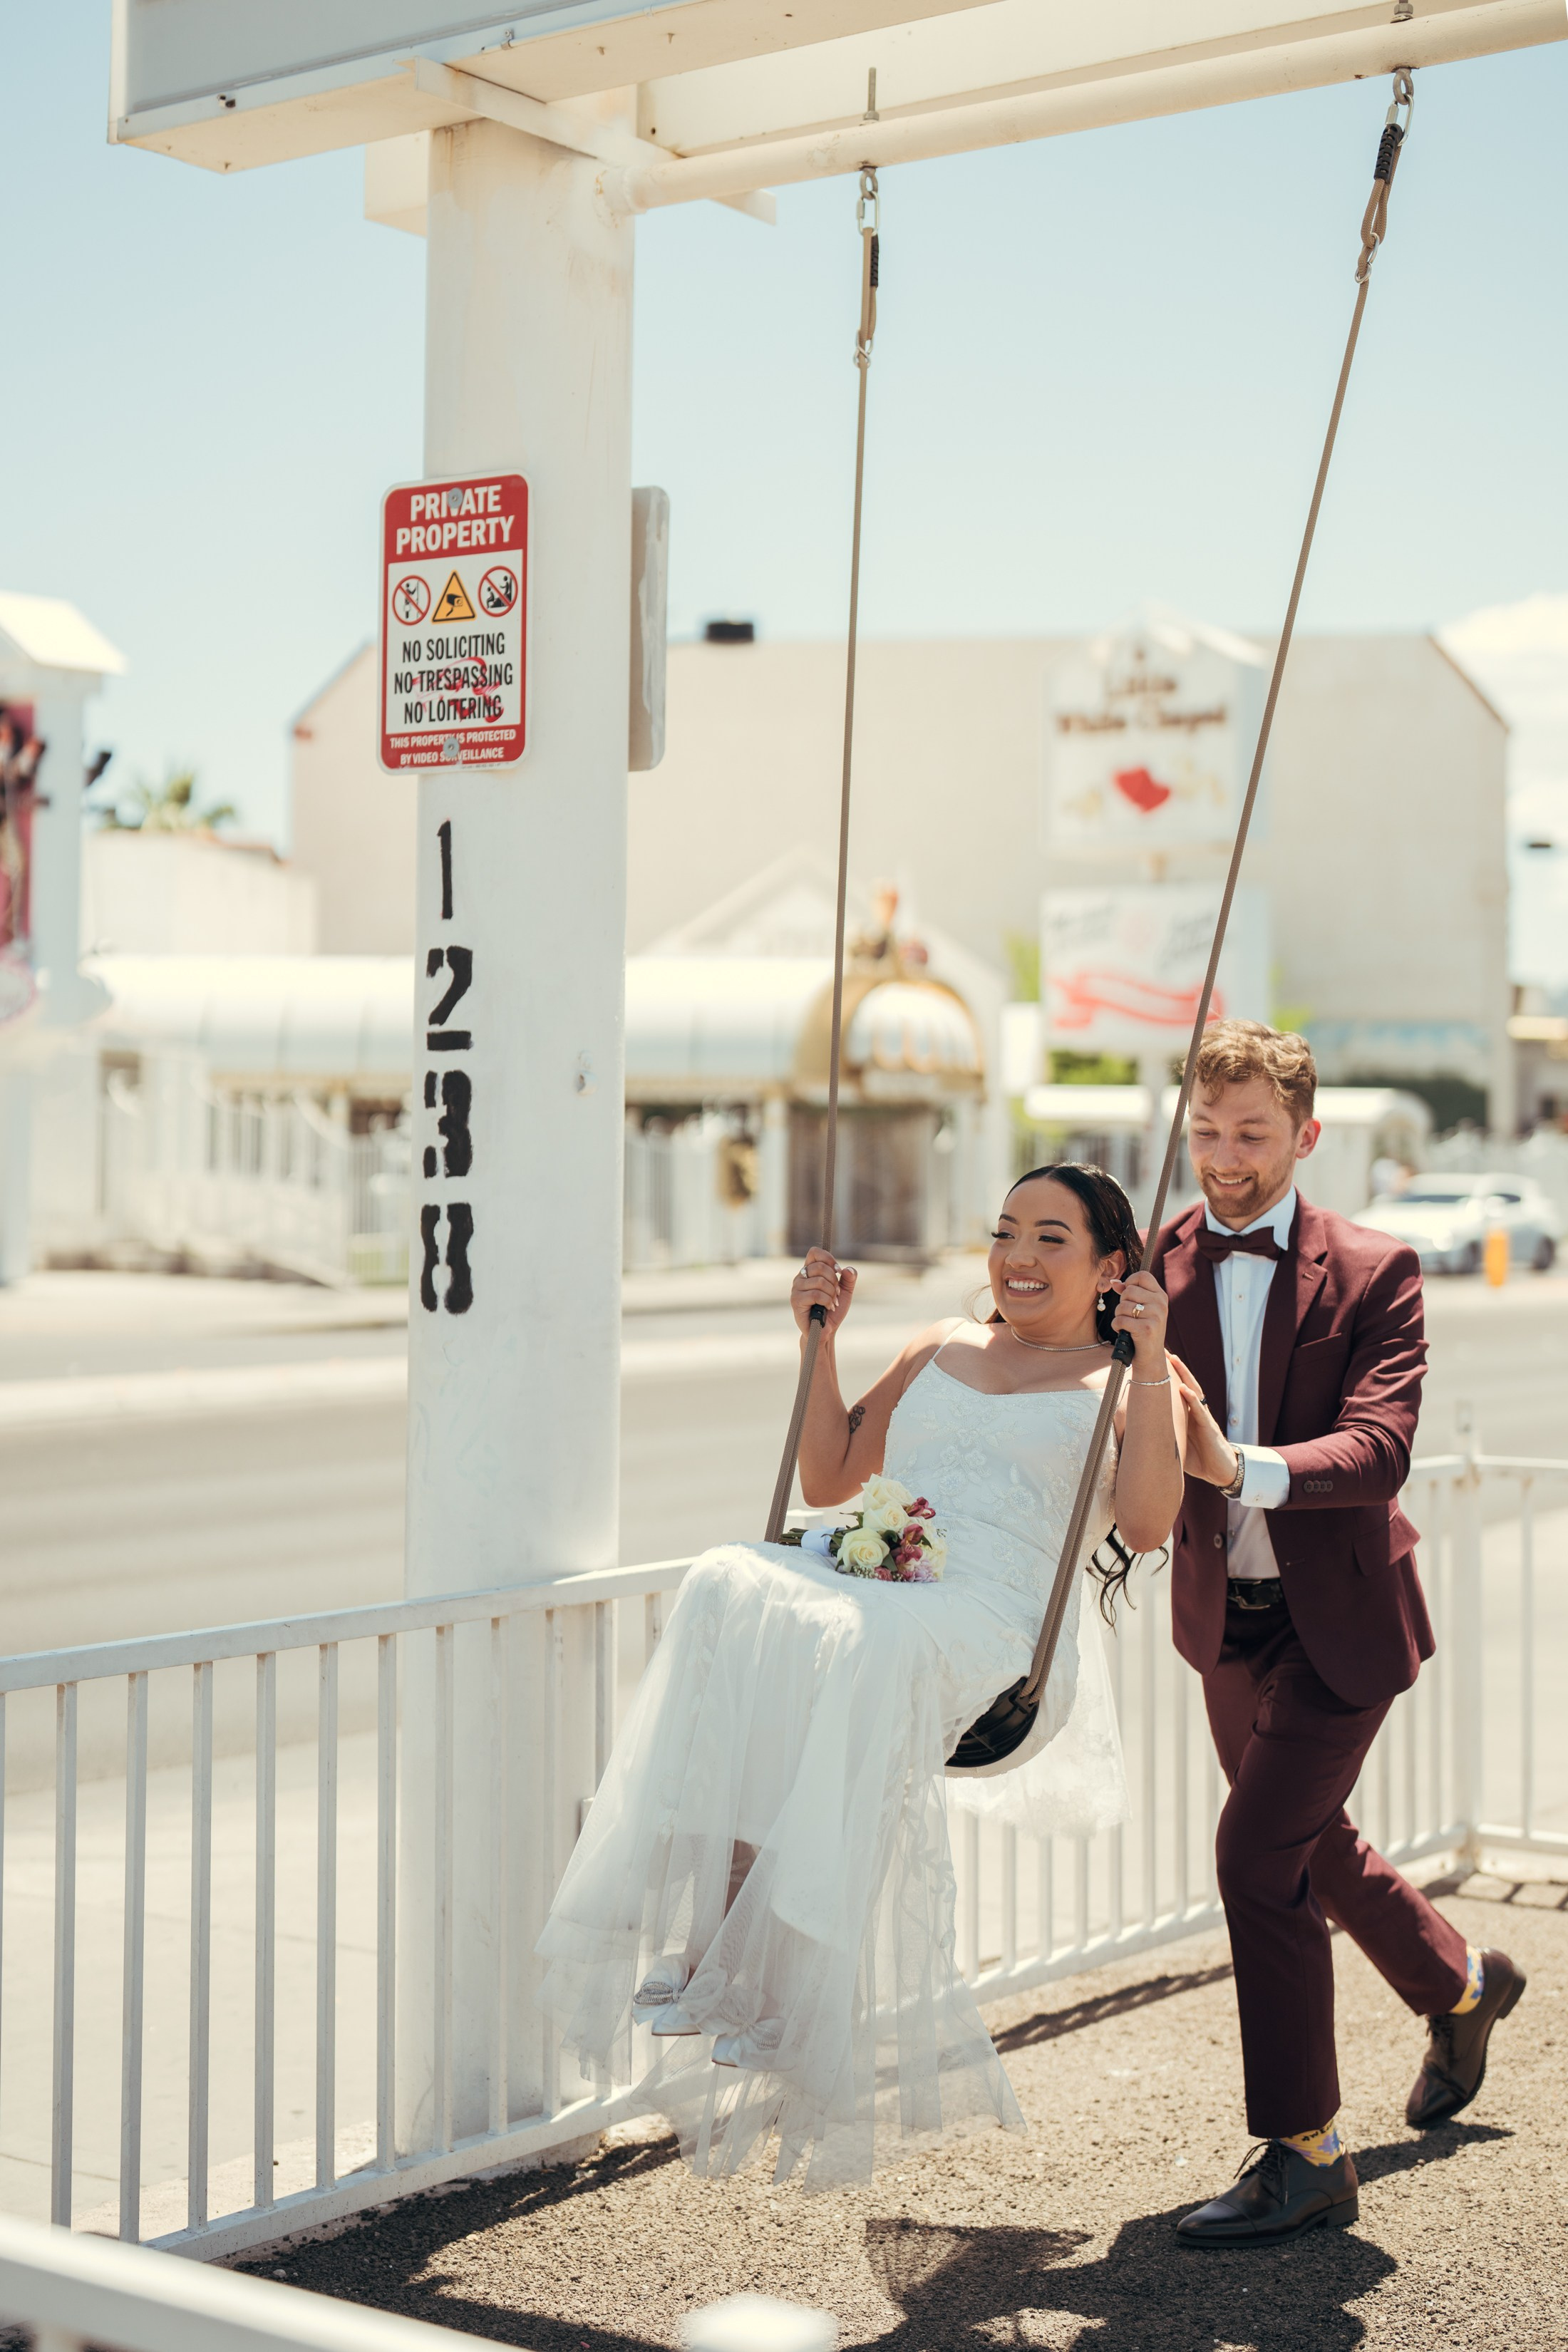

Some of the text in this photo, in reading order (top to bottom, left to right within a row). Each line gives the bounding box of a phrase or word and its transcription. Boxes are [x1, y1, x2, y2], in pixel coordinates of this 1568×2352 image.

[396, 515, 515, 555] PROPERTY
[403, 632, 505, 663] NO SOLICITING
[394, 663, 512, 694] NO TRESPASSING
[404, 695, 502, 724] NO LOITERING
[390, 737, 409, 748] THIS
[466, 729, 516, 743] PROTECTED
[401, 753, 412, 765] BY
[413, 751, 438, 764] VIDEO
